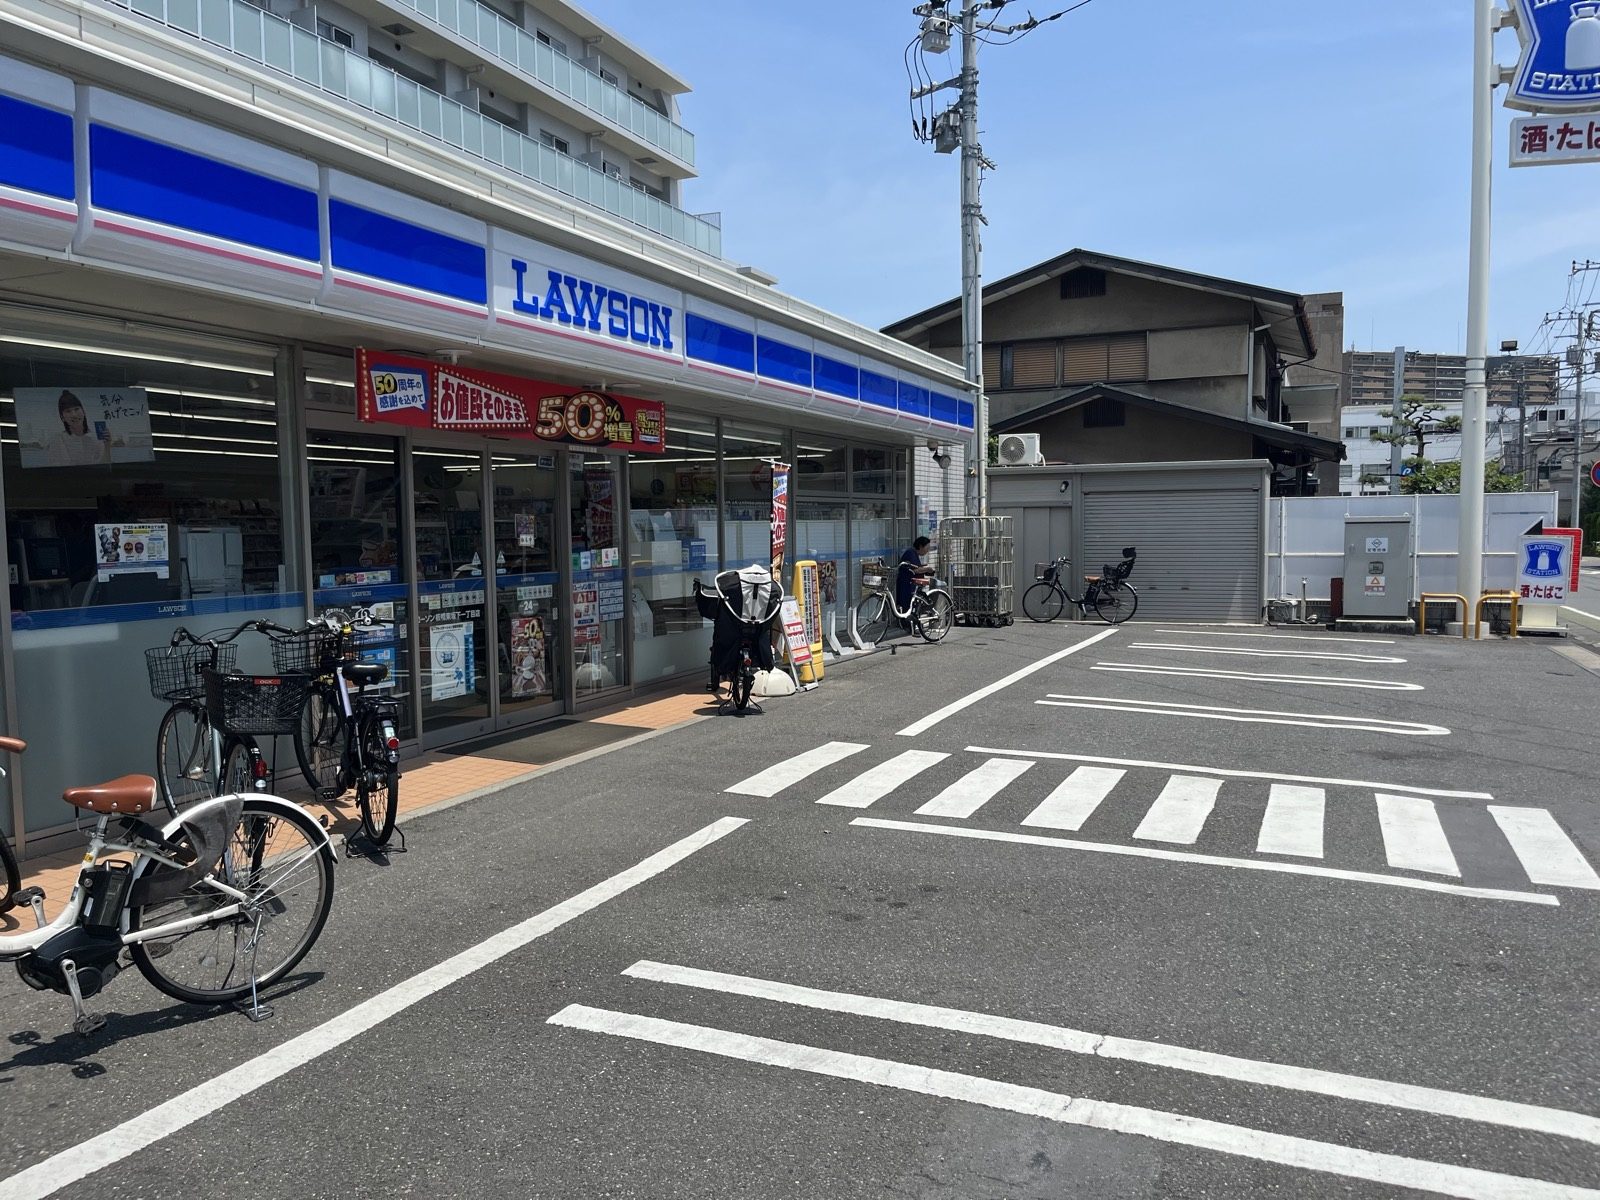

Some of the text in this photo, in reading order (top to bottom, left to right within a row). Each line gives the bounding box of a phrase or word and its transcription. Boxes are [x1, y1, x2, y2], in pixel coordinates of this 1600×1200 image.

[511, 258, 674, 350] LAWSON
[375, 373, 422, 396] 50周年の
[99, 393, 124, 407] 気分
[379, 394, 424, 409] 感謝を込めて
[441, 378, 524, 422] お値段そのまま
[535, 393, 622, 442] 50%
[603, 422, 633, 444] 増量
[1527, 544, 1561, 553] LAWSON
[1526, 568, 1560, 577] STATION
[576, 591, 595, 604] ATM
[1520, 584, 1564, 600] 酒・たばこ
[158, 604, 187, 614] LAWSON
[523, 600, 534, 611] 24
